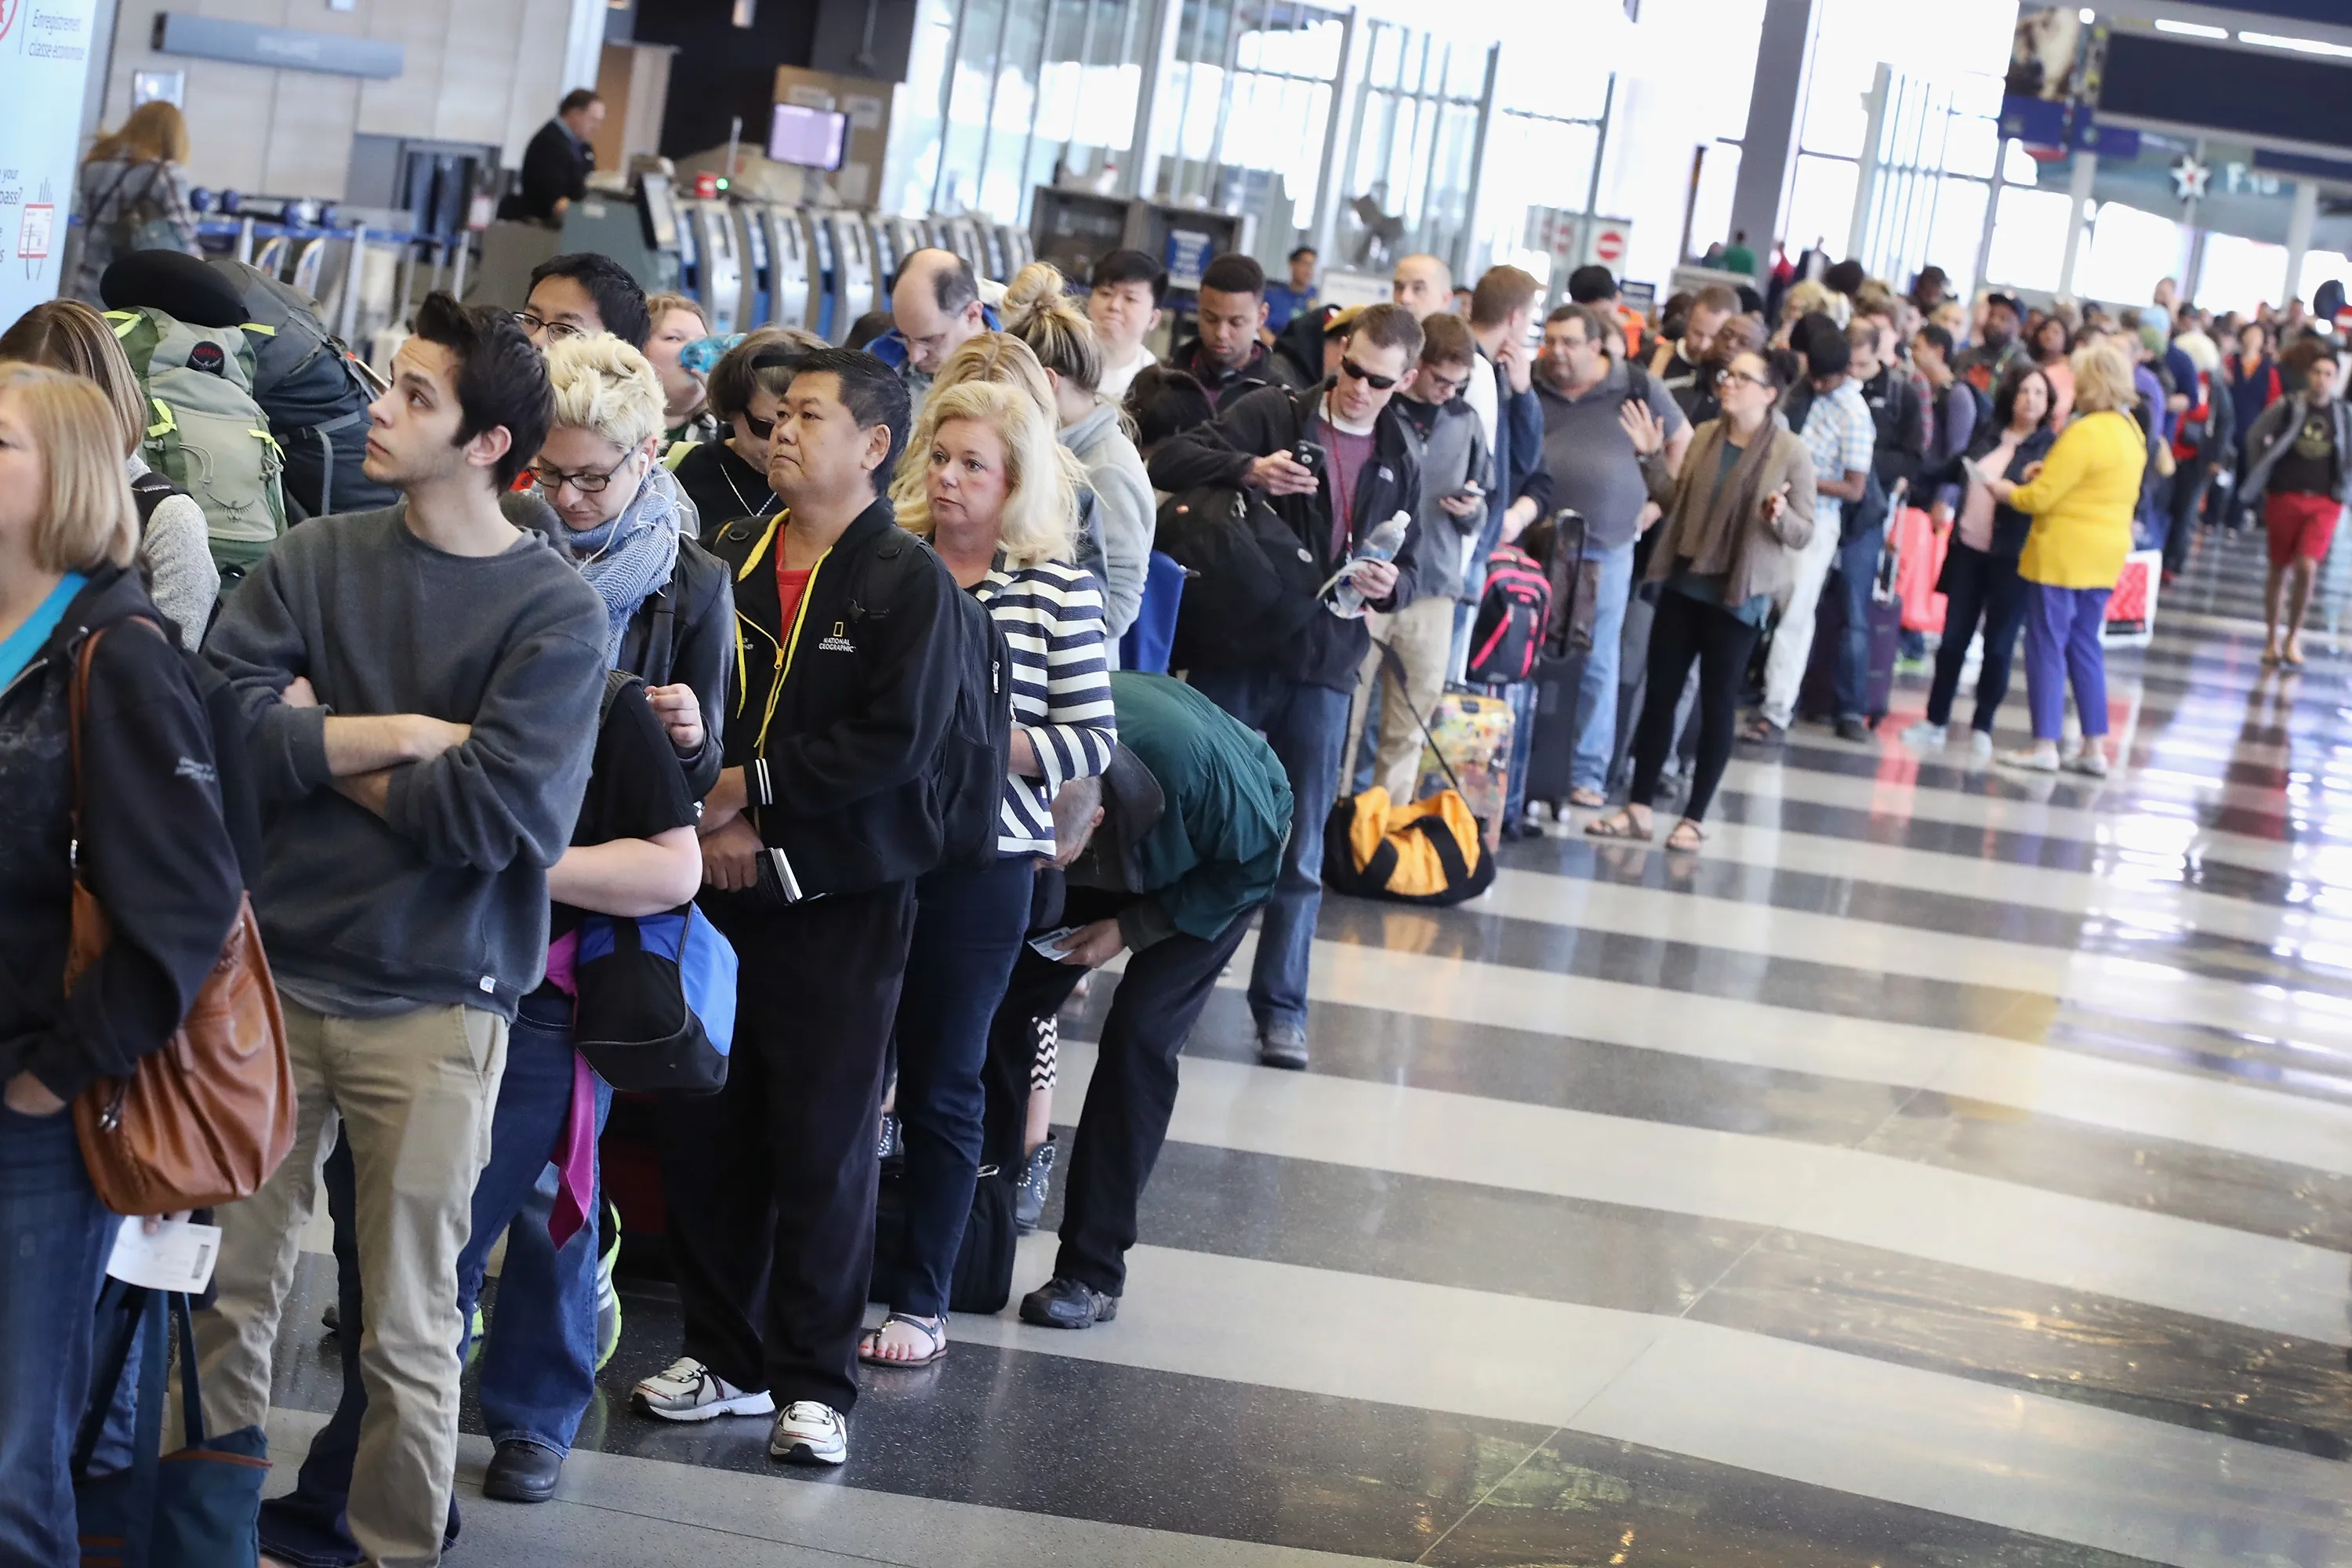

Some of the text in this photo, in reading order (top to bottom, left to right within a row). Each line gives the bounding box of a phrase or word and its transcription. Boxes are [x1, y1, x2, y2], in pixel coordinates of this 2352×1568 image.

[32, 9, 82, 35] Enregistrement
[28, 36, 51, 58] classe
[818, 643, 855, 653] GEOGRAPHIC
[823, 637, 851, 645] NATIONAL
